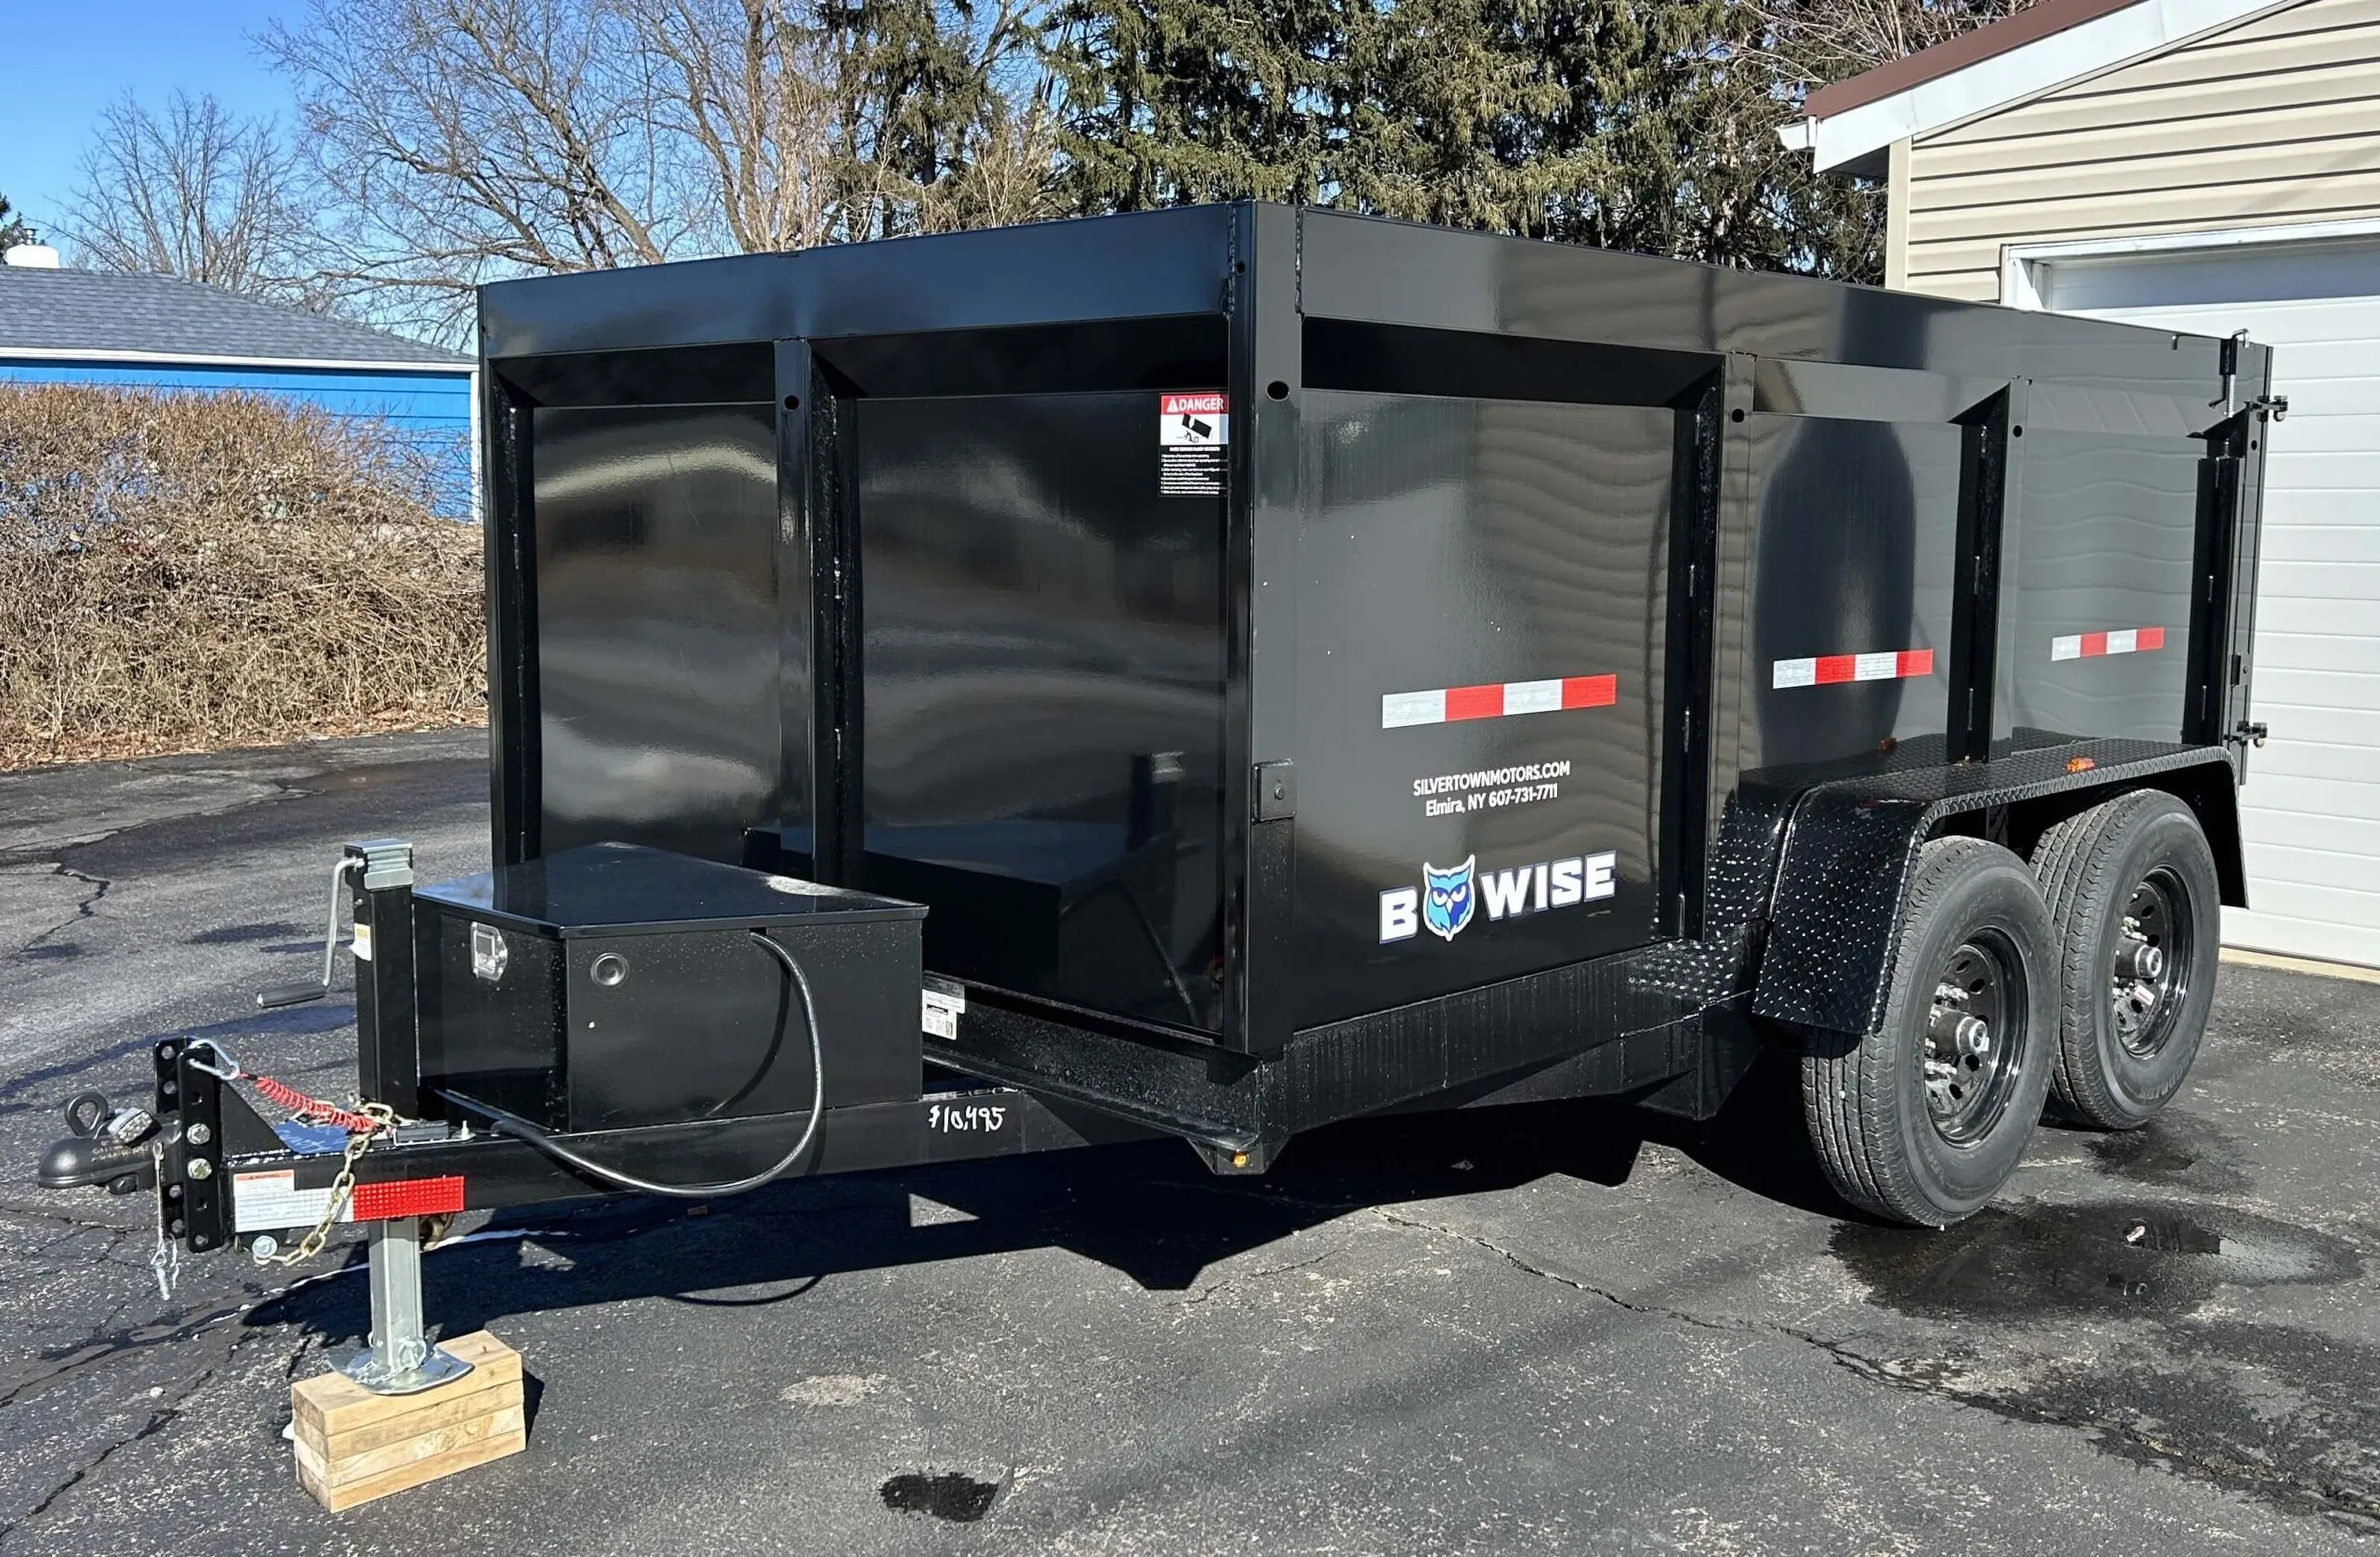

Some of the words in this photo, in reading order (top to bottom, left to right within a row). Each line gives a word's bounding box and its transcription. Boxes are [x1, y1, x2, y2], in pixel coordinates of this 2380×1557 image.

[1178, 397, 1224, 412] DANGER
[1412, 760, 1571, 797] SILVERTOWNMOTORS.COM
[1425, 797, 1466, 817] Elmira,
[1467, 792, 1487, 811] NY
[1488, 783, 1558, 808] 607-731-7711
[928, 1104, 1006, 1133] $10,495
